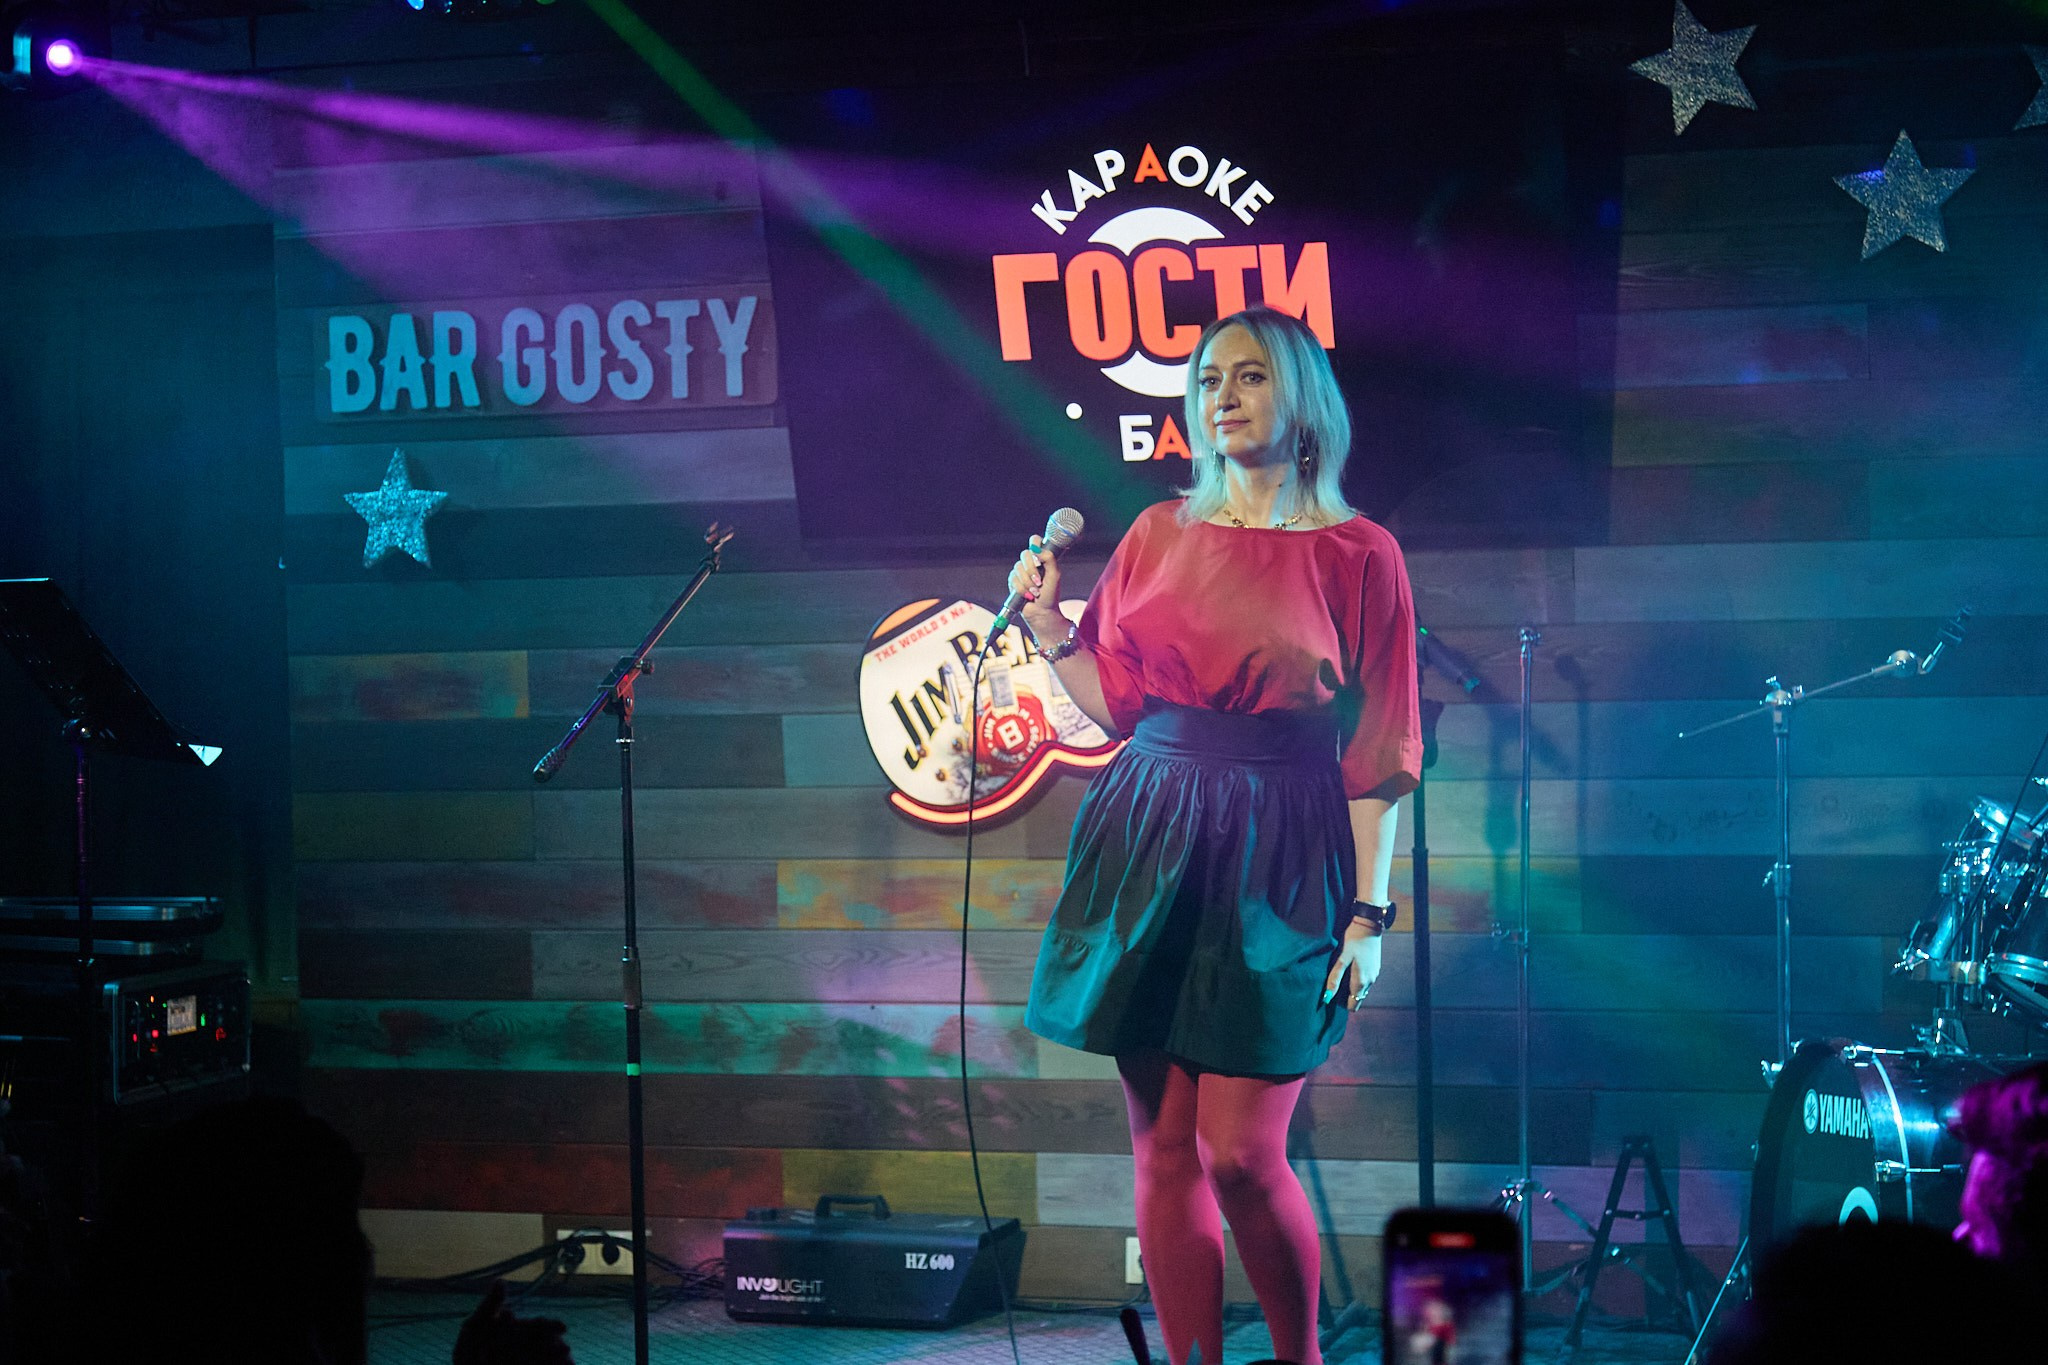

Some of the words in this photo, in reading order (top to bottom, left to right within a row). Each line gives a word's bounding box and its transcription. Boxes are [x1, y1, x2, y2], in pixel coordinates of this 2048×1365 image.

[1031, 142, 1275, 236] КАРАОКЕ
[992, 241, 1335, 362] ГОСТИ
[325, 310, 481, 413] BAR
[496, 296, 758, 407] GOSTY
[1119, 413, 1193, 462] БА
[874, 639, 898, 662] THE
[888, 660, 951, 771] JIM
[1819, 1093, 1869, 1140] YAMAHA
[904, 1252, 929, 1270] HZ
[929, 1253, 955, 1271] 600
